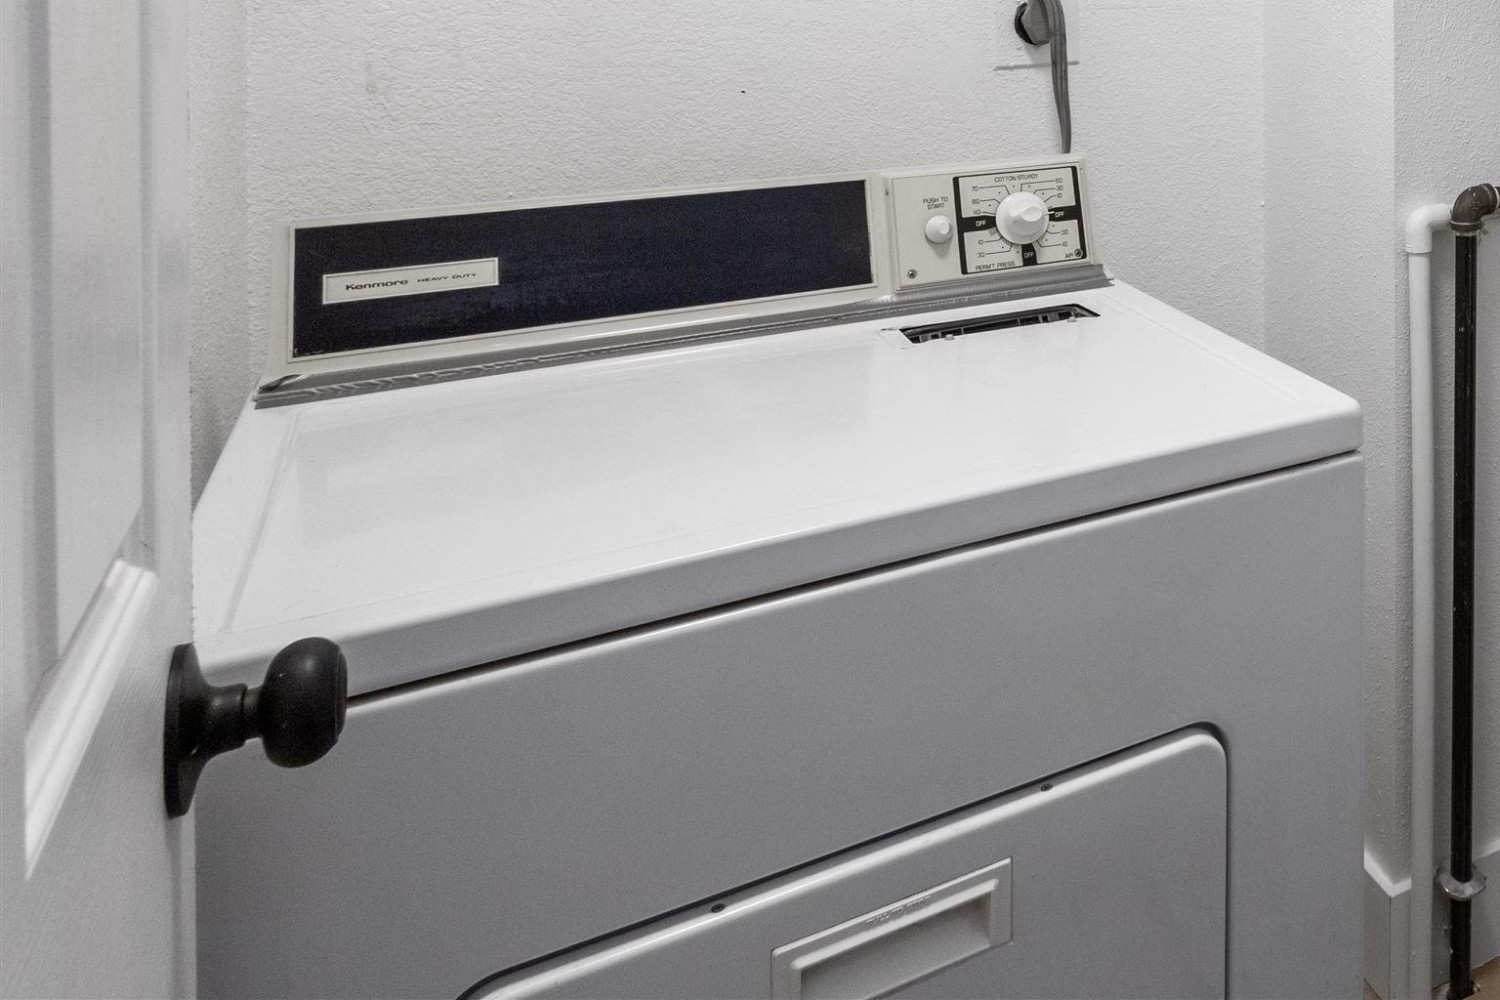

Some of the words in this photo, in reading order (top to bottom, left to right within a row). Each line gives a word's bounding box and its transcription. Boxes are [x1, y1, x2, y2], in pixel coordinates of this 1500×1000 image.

[975, 219, 987, 227] OFF
[1023, 251, 1035, 259] OFF
[345, 279, 408, 291] Kenmore
[417, 275, 449, 283] HEAVY
